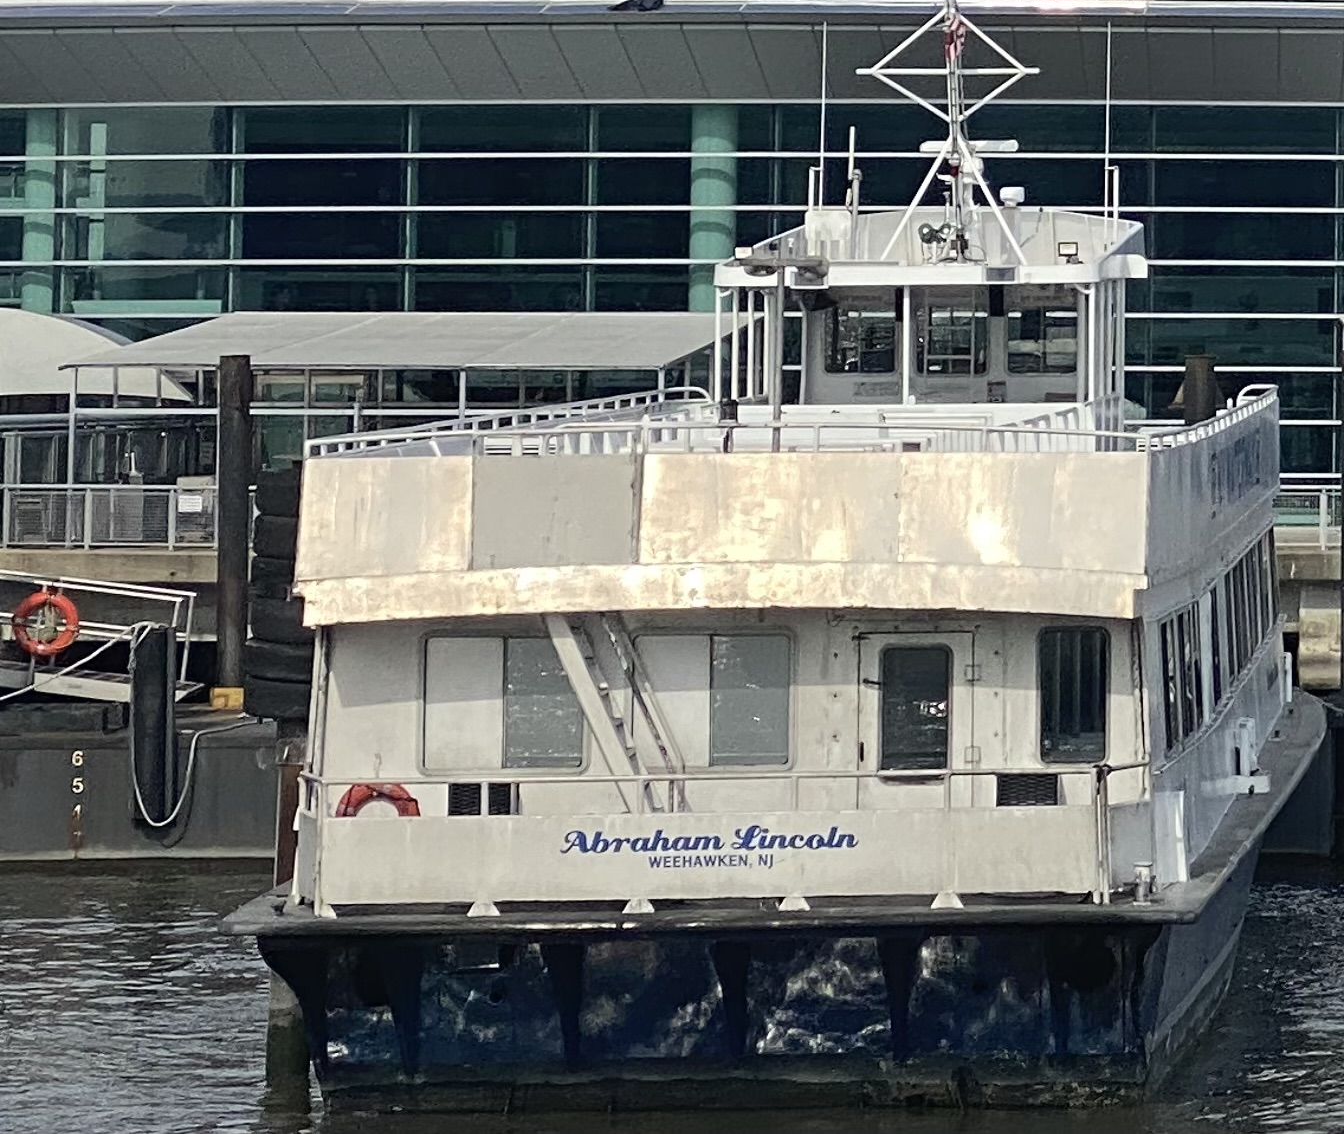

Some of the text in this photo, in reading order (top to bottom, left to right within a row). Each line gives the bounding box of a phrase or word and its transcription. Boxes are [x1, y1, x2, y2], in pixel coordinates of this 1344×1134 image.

[72, 750, 84, 766] 6
[72, 777, 84, 794] 5
[560, 825, 859, 854] Abraham Lincoln
[649, 853, 775, 869] WEEHAWKEN, NJ
